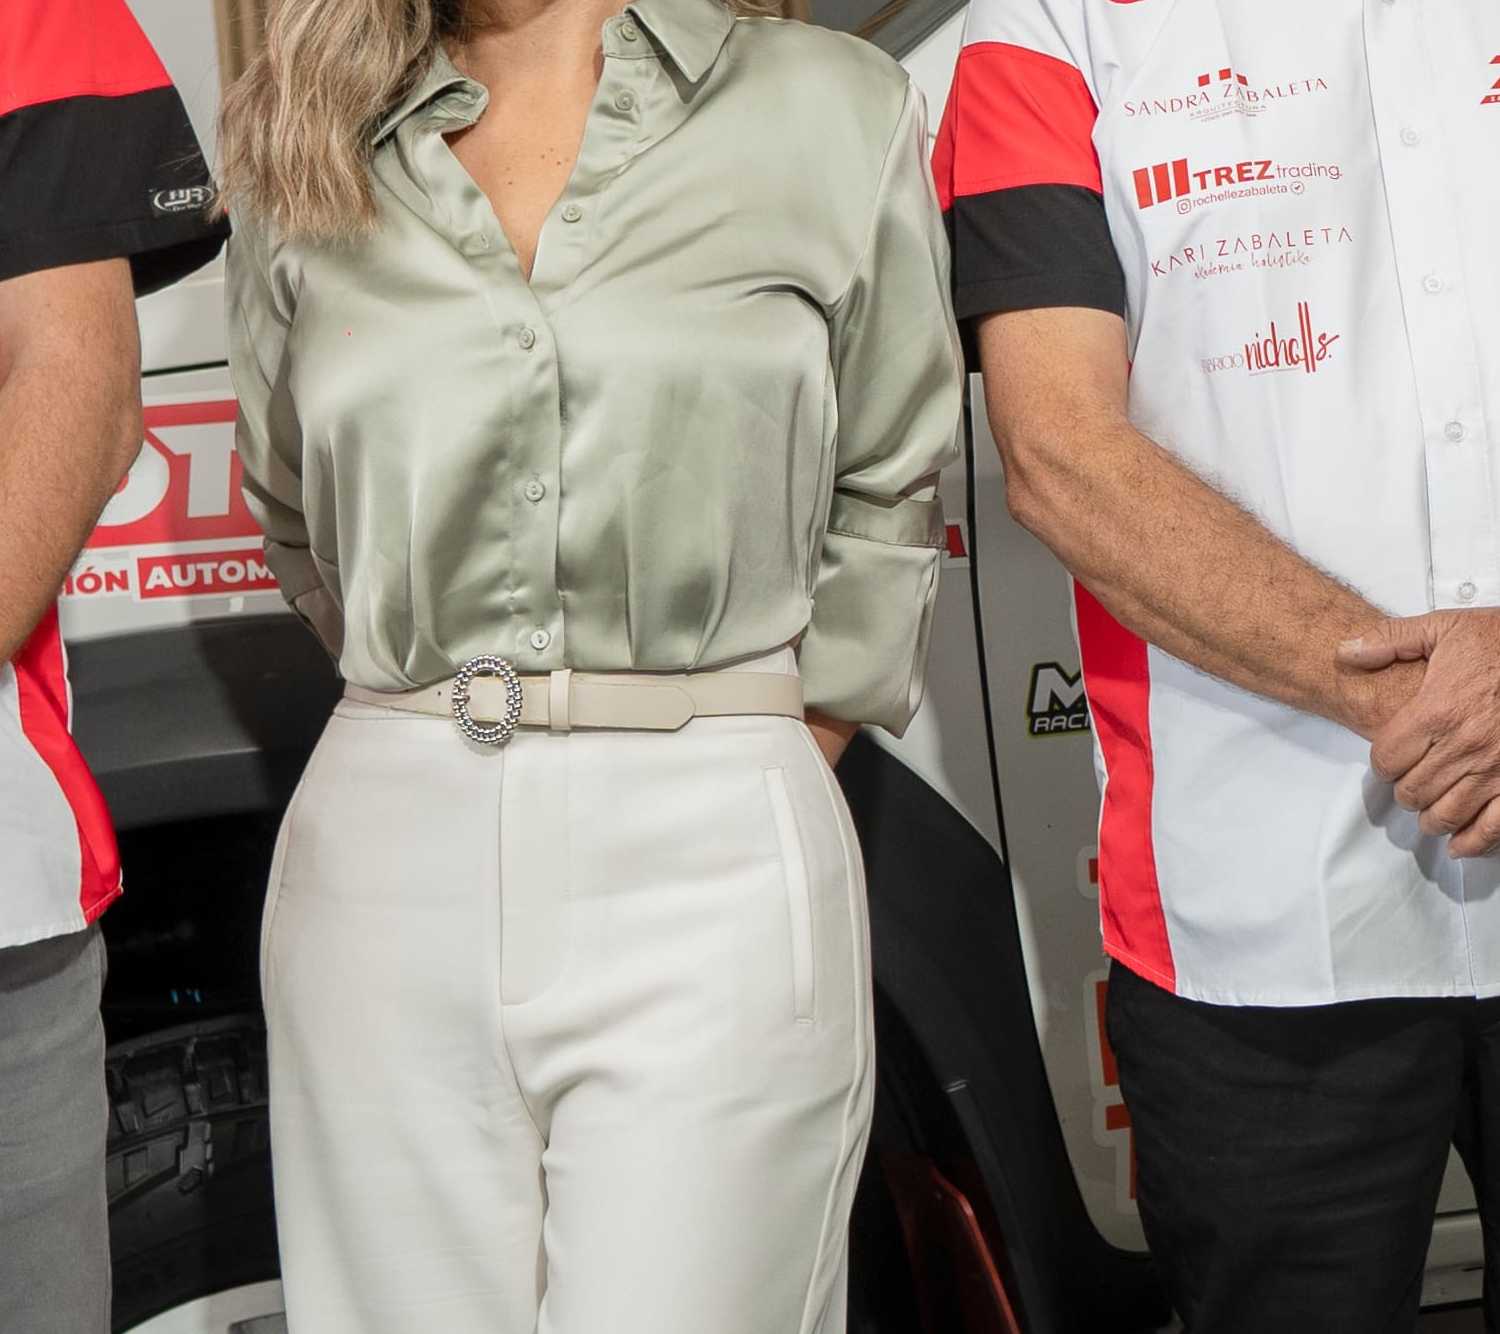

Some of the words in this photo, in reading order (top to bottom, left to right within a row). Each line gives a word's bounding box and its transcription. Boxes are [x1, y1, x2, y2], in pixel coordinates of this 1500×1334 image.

[1124, 91, 1210, 116] SANDRA
[1223, 78, 1328, 102] ZABALETA
[1193, 160, 1275, 191] TREZ
[1193, 183, 1288, 207] rochellezabaleta
[1150, 245, 1205, 277] KARI
[1216, 226, 1353, 256] ZABALETA
[60, 566, 129, 596] IÓN
[145, 559, 276, 590] AUTOM
